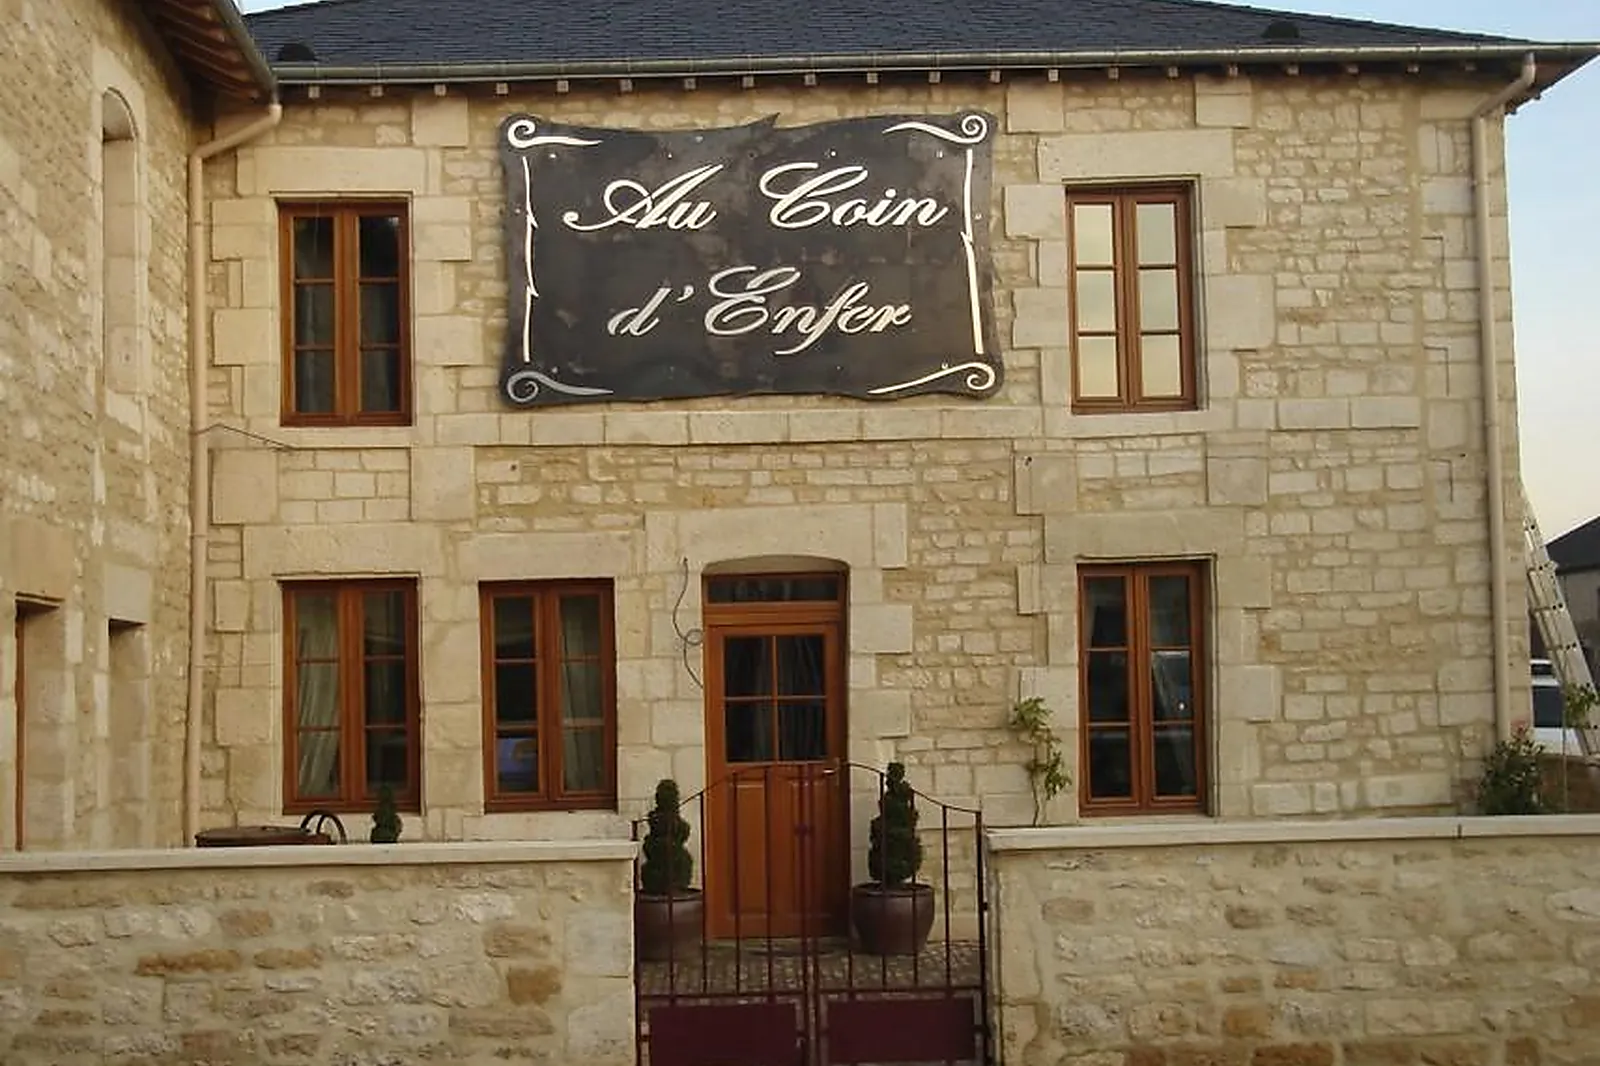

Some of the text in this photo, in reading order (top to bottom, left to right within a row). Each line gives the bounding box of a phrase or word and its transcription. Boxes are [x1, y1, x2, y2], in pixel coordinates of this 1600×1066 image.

[563, 162, 951, 232] Au Coin
[607, 265, 912, 355] d'Enfer
